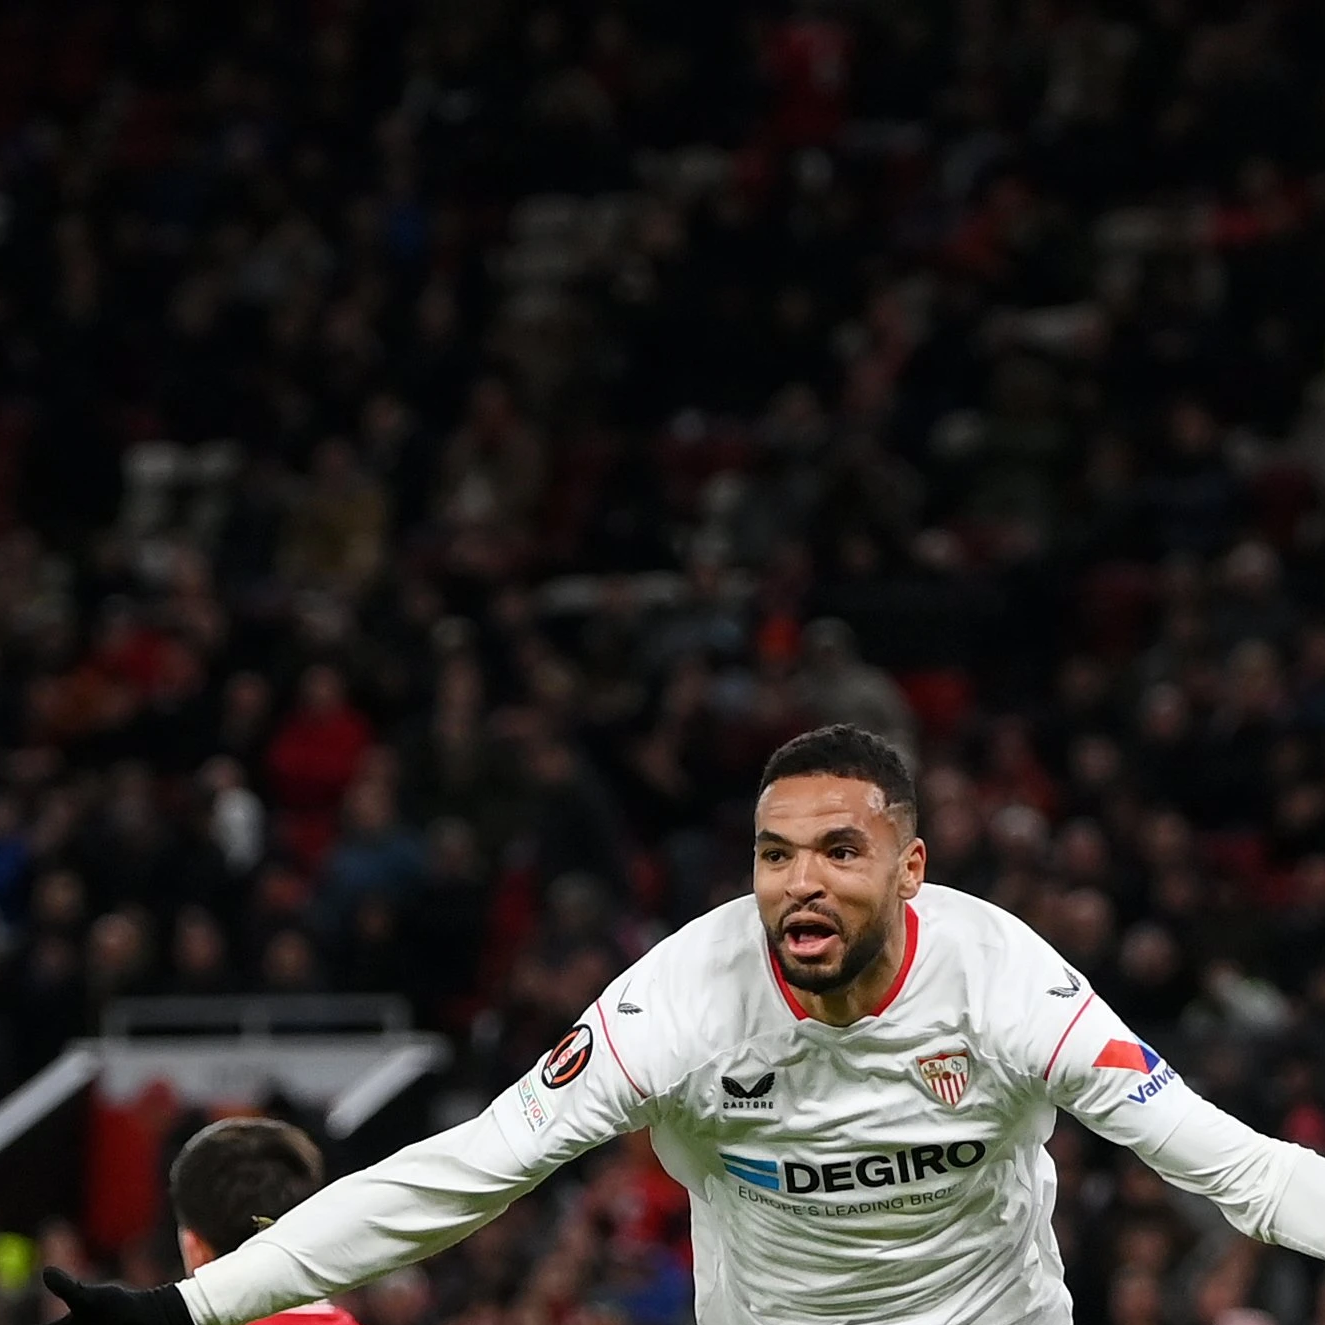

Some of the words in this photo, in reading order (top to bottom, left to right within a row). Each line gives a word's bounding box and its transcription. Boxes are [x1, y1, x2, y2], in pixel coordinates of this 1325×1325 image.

[722, 1100, 775, 1110] CASTORE
[783, 1139, 987, 1195] DEGIRO
[825, 1197, 905, 1218] LEADING
